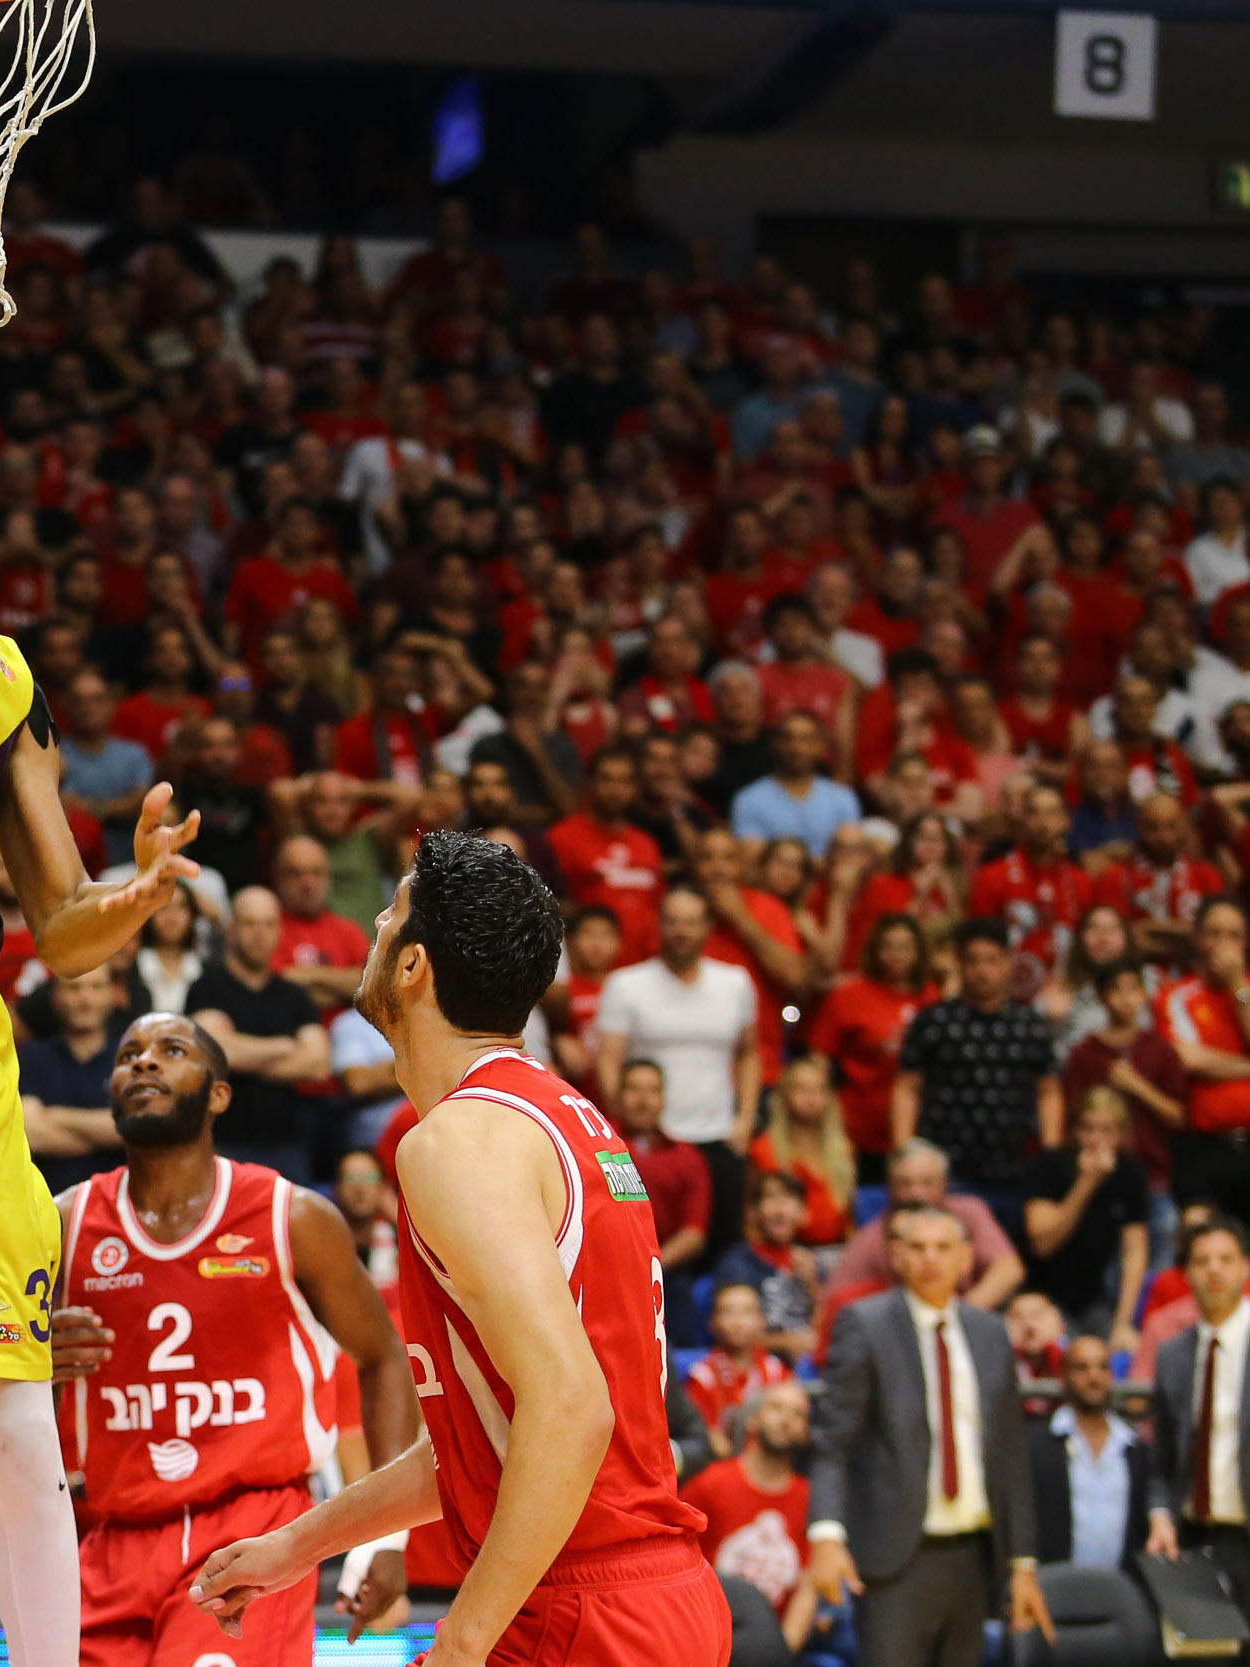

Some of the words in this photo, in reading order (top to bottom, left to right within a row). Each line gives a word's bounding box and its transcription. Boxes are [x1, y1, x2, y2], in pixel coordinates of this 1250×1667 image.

[1085, 34, 1125, 95] 8
[147, 1302, 195, 1372] 2
[100, 1382, 168, 1431] יהב
[174, 1378, 267, 1438] בנק
